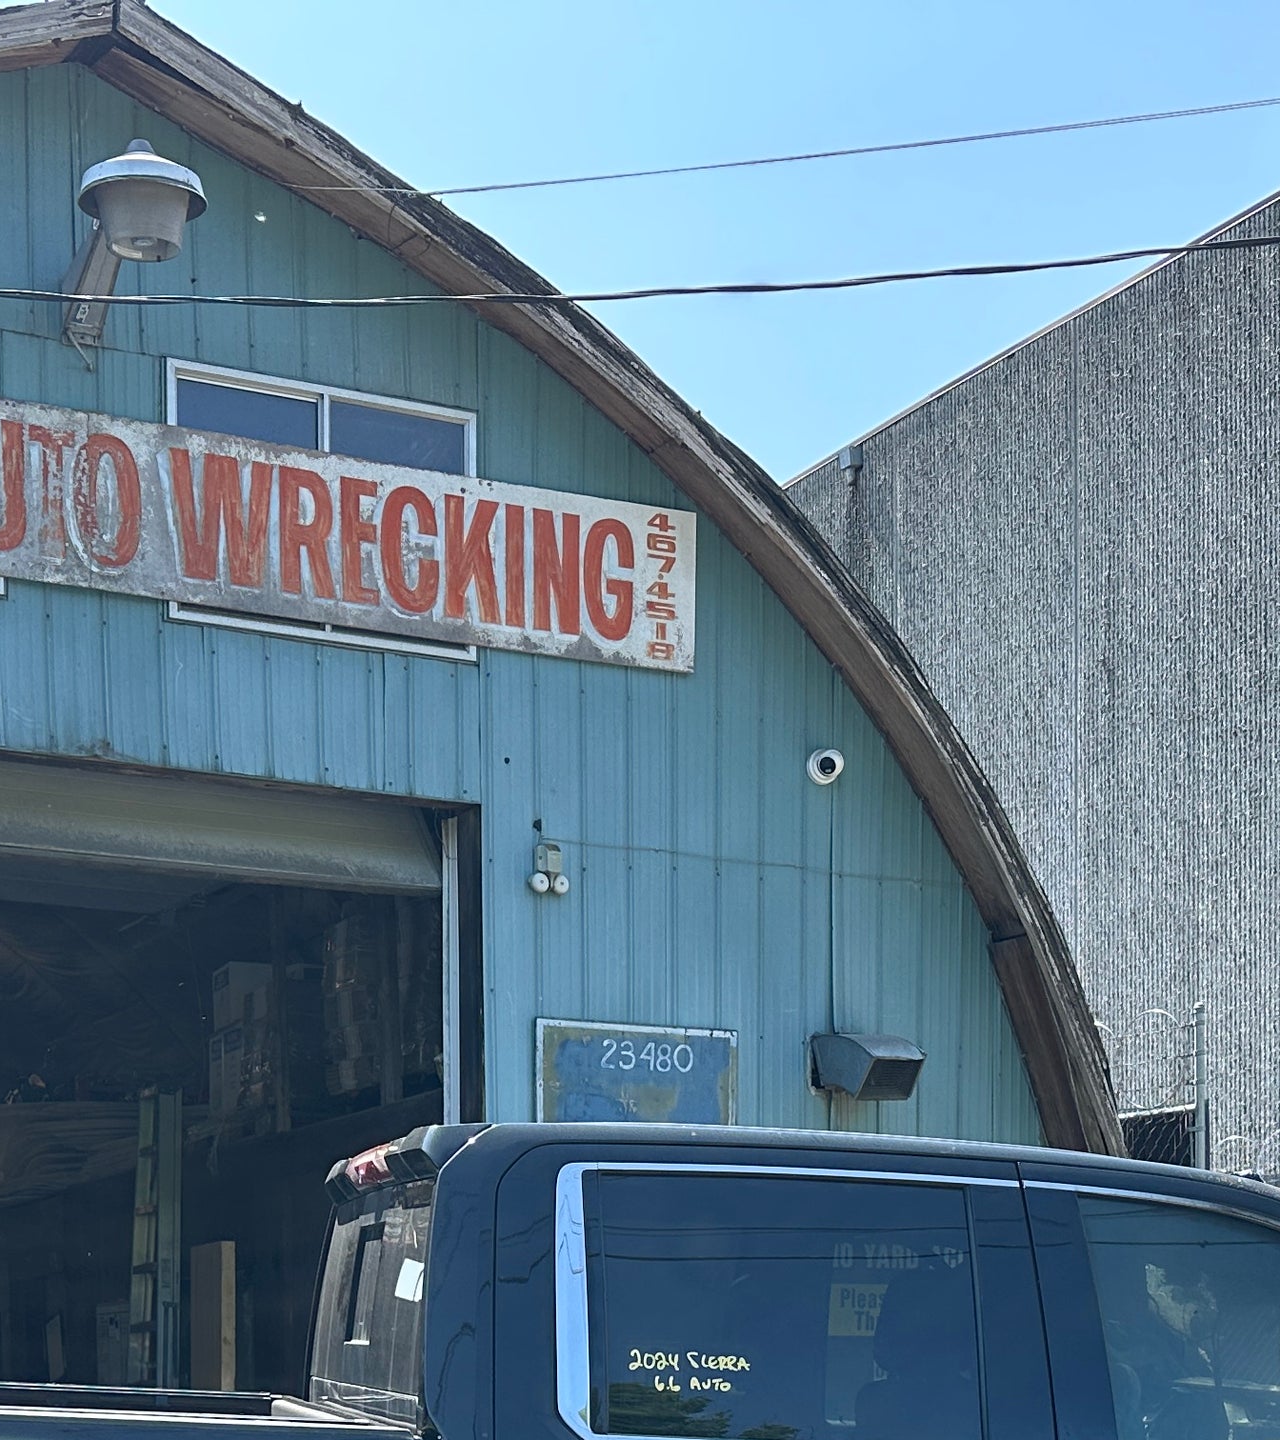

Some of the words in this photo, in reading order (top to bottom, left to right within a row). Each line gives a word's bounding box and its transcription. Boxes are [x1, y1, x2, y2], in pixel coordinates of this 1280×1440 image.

[168, 448, 636, 641] WRECKING
[600, 1038, 694, 1073] 23480
[628, 1349, 680, 1371] 2024
[690, 1376, 732, 1392] AUTO
